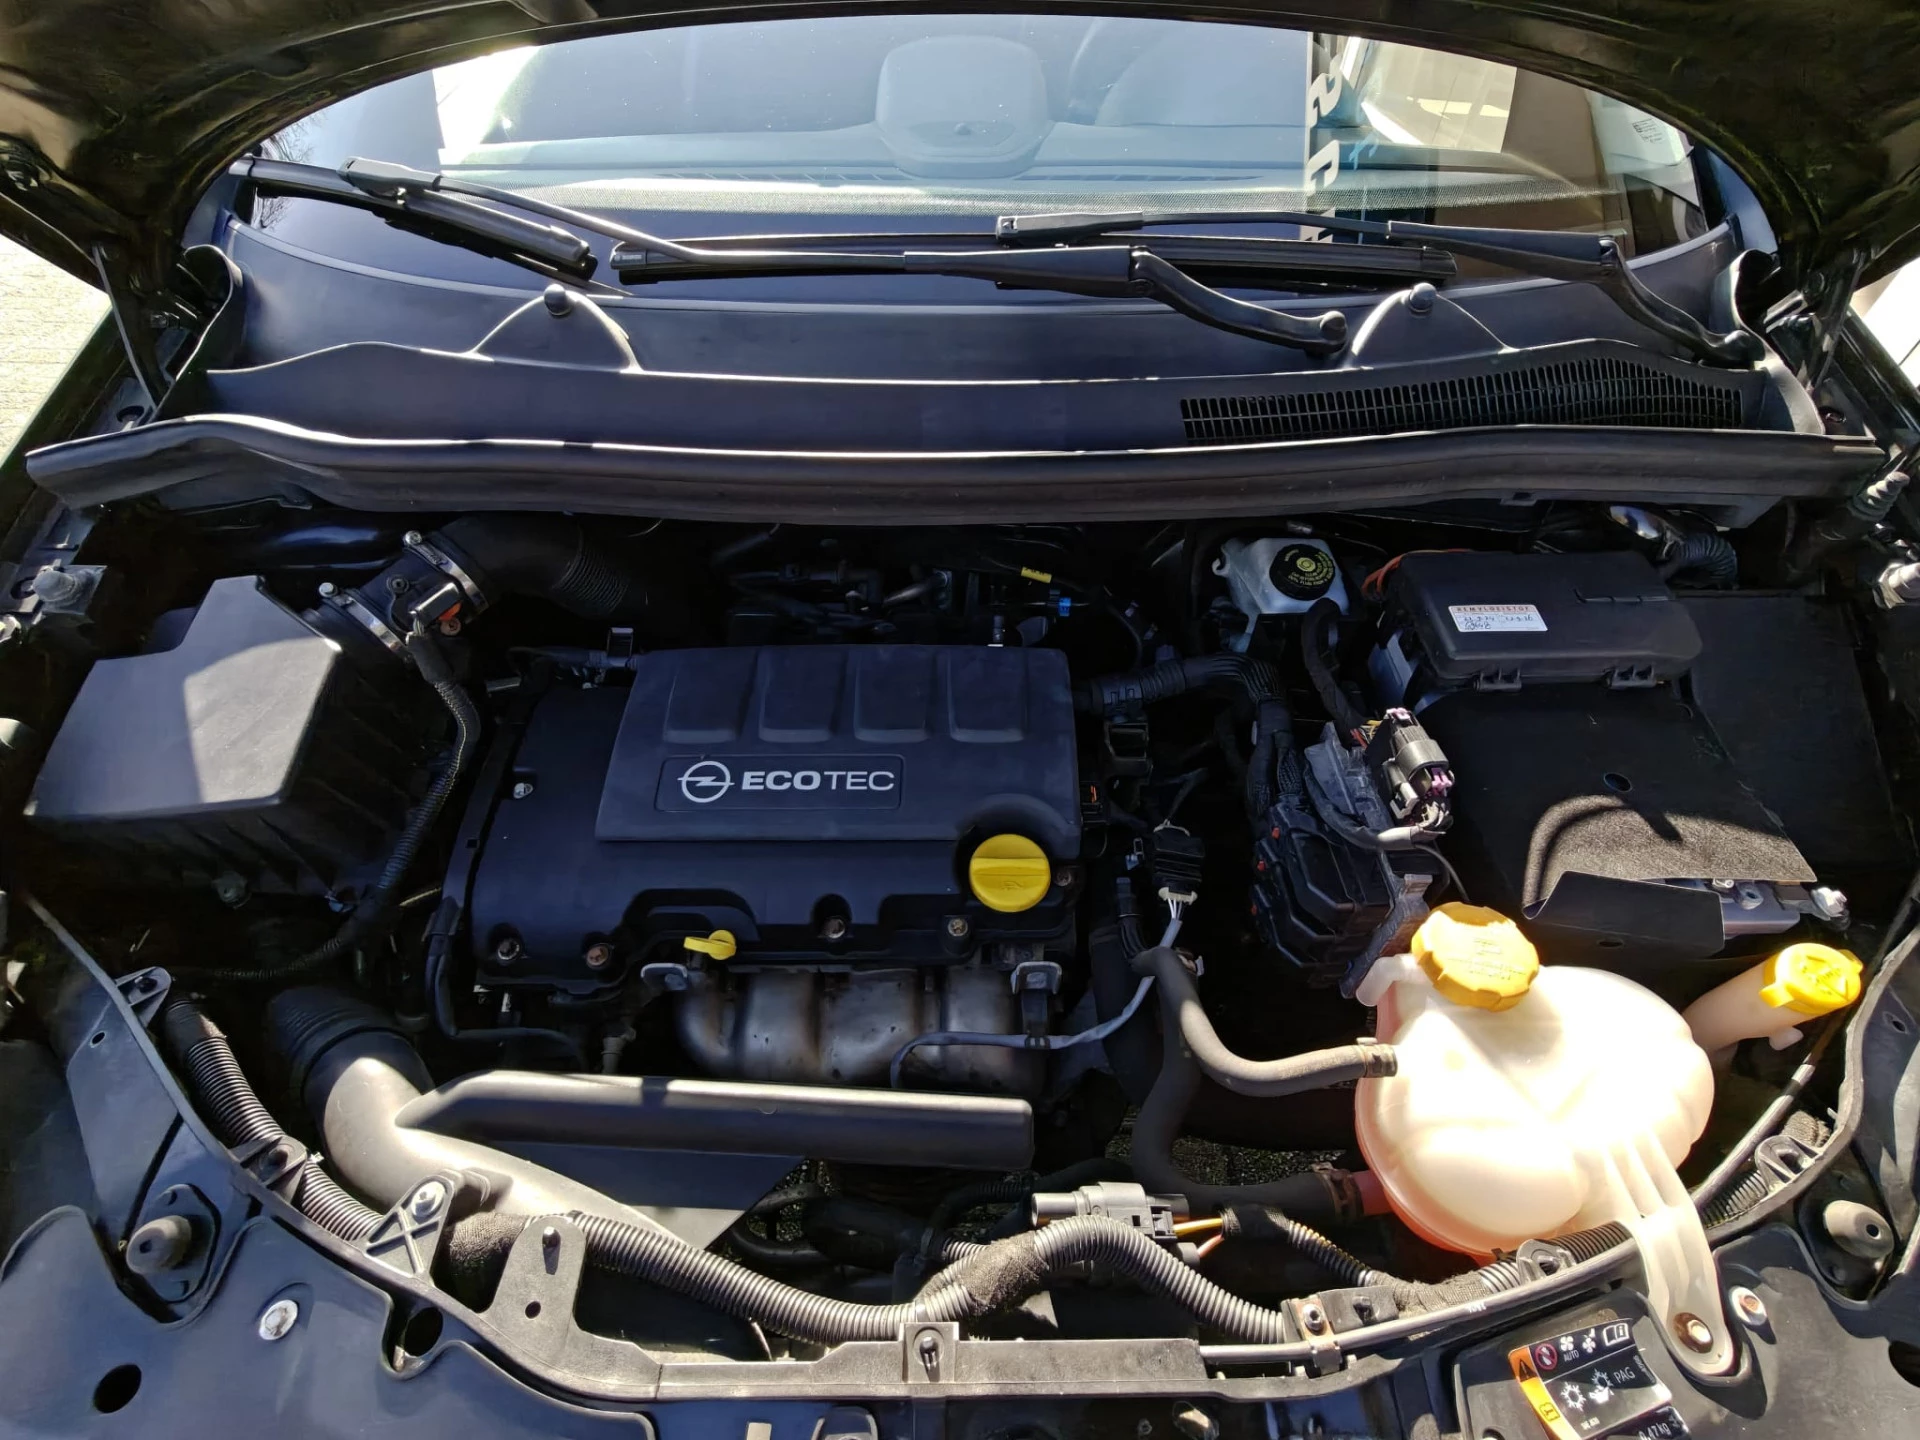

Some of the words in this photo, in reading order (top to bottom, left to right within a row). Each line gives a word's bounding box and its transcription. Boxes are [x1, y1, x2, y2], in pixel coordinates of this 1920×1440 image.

[741, 770, 895, 791] ECOTEC
[1563, 1349, 1580, 1362] AUTO
[1613, 1366, 1636, 1383] PAG
